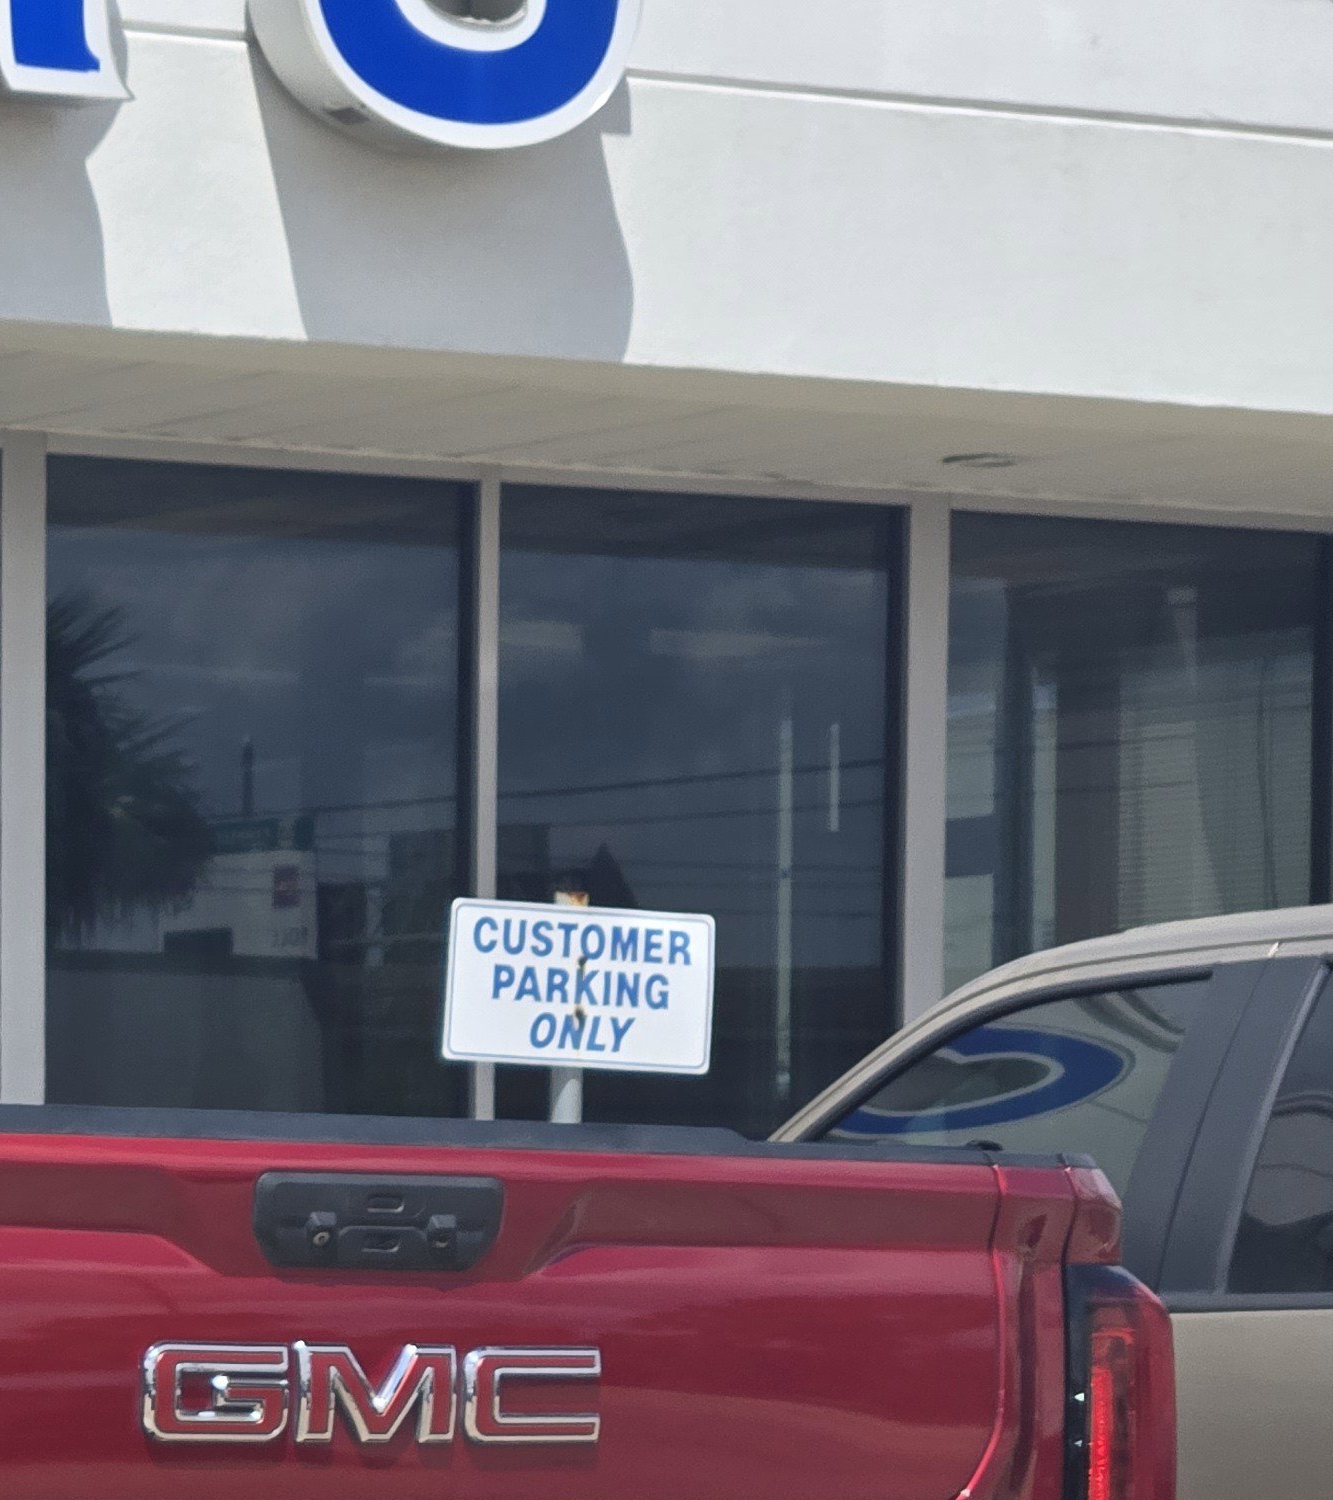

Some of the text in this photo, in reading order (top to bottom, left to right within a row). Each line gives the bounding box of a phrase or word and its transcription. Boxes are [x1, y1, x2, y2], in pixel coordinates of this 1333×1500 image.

[473, 916, 692, 966] CUSTOMER
[491, 963, 670, 1010] PARKING
[530, 1012, 636, 1053] ONLY
[142, 1341, 602, 1444] GMC
